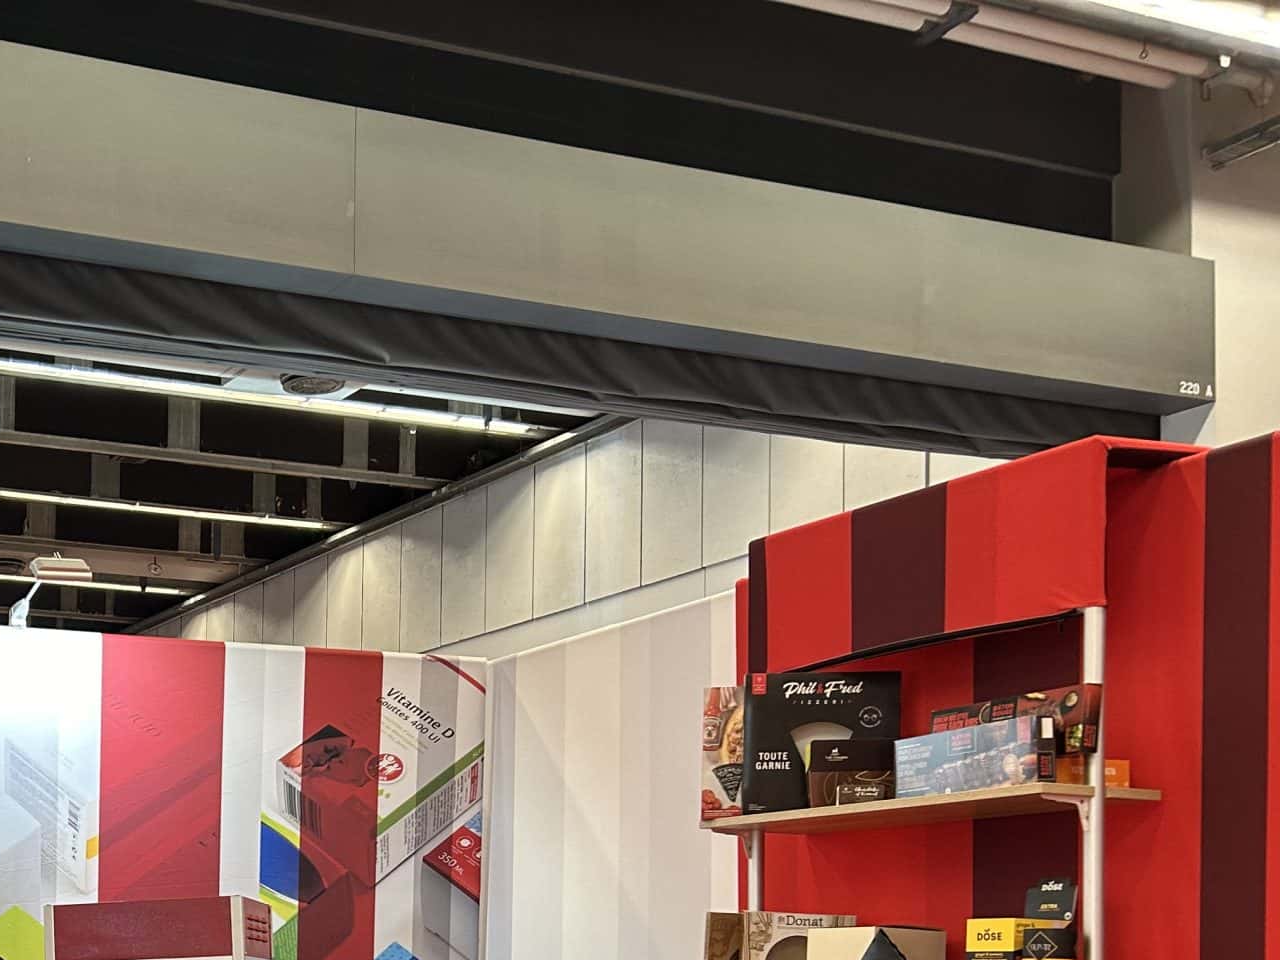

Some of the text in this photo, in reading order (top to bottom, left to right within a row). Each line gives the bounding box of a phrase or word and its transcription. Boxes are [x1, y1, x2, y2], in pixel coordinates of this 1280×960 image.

[783, 681, 818, 698] Phil
[824, 679, 865, 698] Fred
[386, 687, 442, 730] Vitamine
[443, 727, 456, 740] D
[410, 718, 430, 736] 400
[755, 760, 791, 771] GARNIE
[758, 752, 789, 761] TOUTE
[437, 850, 455, 869] 350
